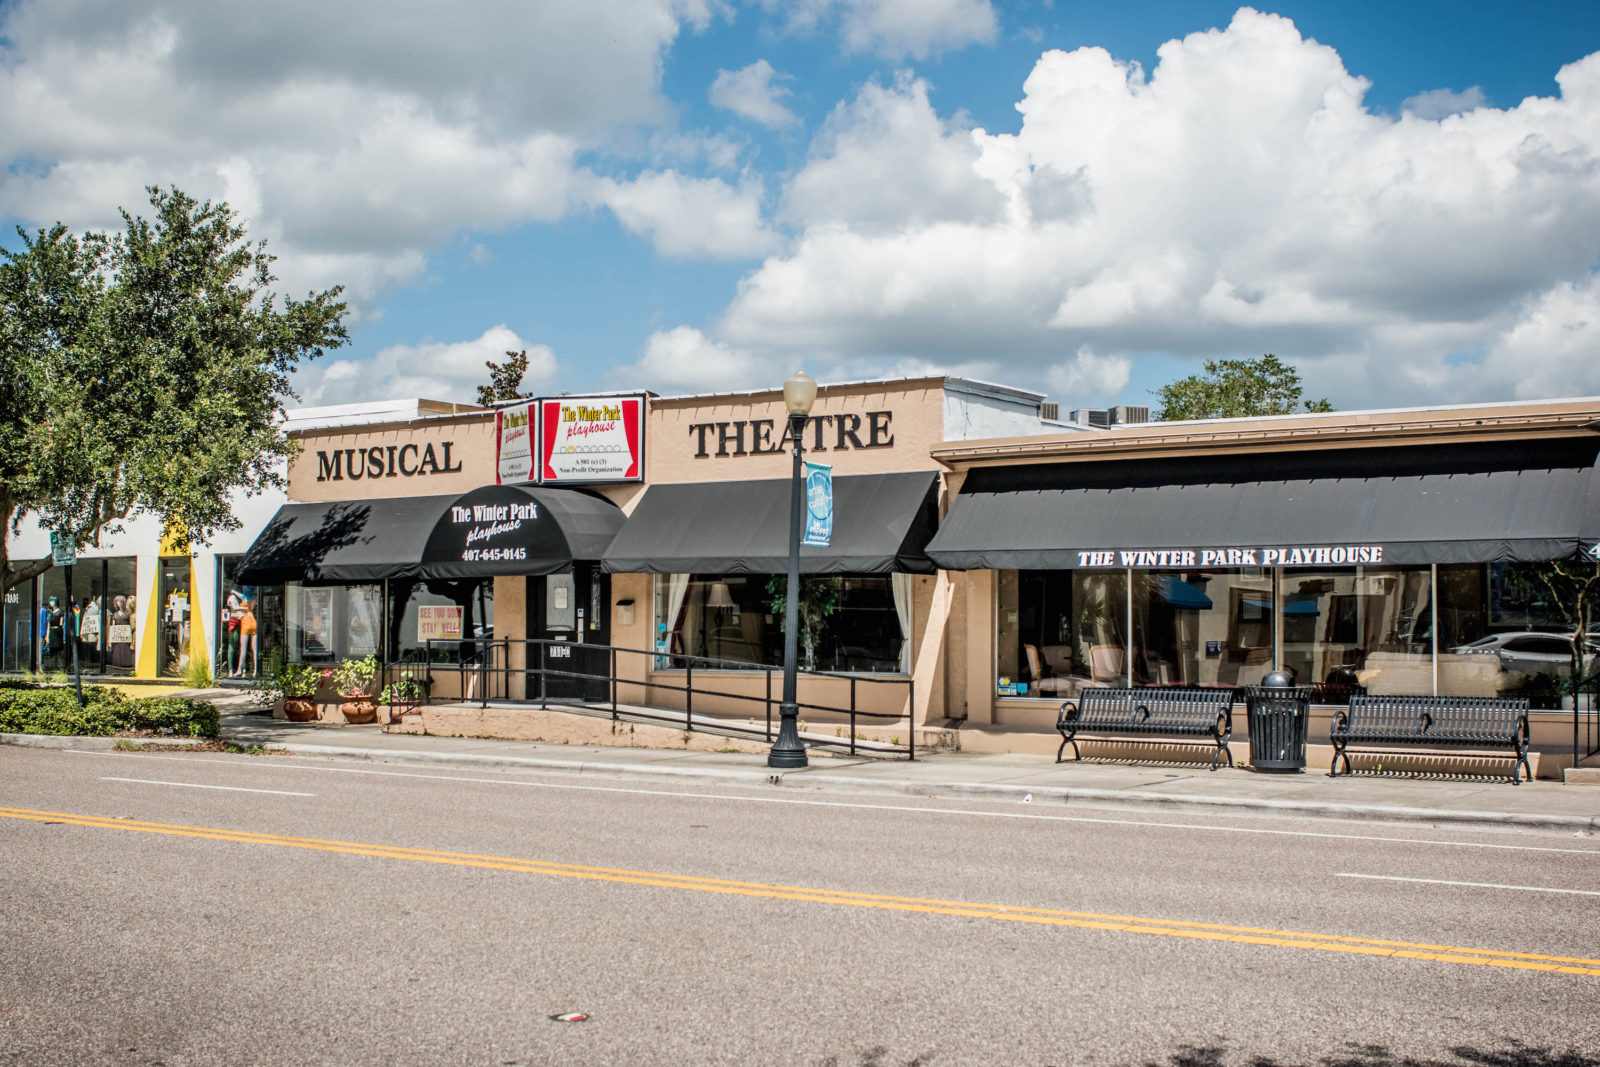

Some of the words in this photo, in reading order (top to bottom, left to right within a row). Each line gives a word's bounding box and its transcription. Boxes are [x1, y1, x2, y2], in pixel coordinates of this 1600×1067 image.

[562, 406, 576, 422] The
[577, 406, 602, 421] Winter
[603, 405, 621, 421] Park
[566, 421, 616, 440] playhouse
[689, 410, 894, 458] THEATRE
[316, 441, 462, 481] MUSICAL
[587, 466, 623, 474] Organization
[451, 506, 471, 523] The
[473, 504, 508, 522] Winter
[509, 502, 538, 520] Park
[466, 519, 522, 547] playhouse
[462, 547, 527, 561] 407-645-0145
[1078, 551, 1114, 567] THE
[1120, 550, 1195, 566] WINTER
[1201, 549, 1257, 566] PARK
[1262, 546, 1383, 565] PLAYHOUSE
[420, 607, 431, 618] SEE
[433, 607, 445, 619] YOU
[421, 622, 437, 633] STAY
